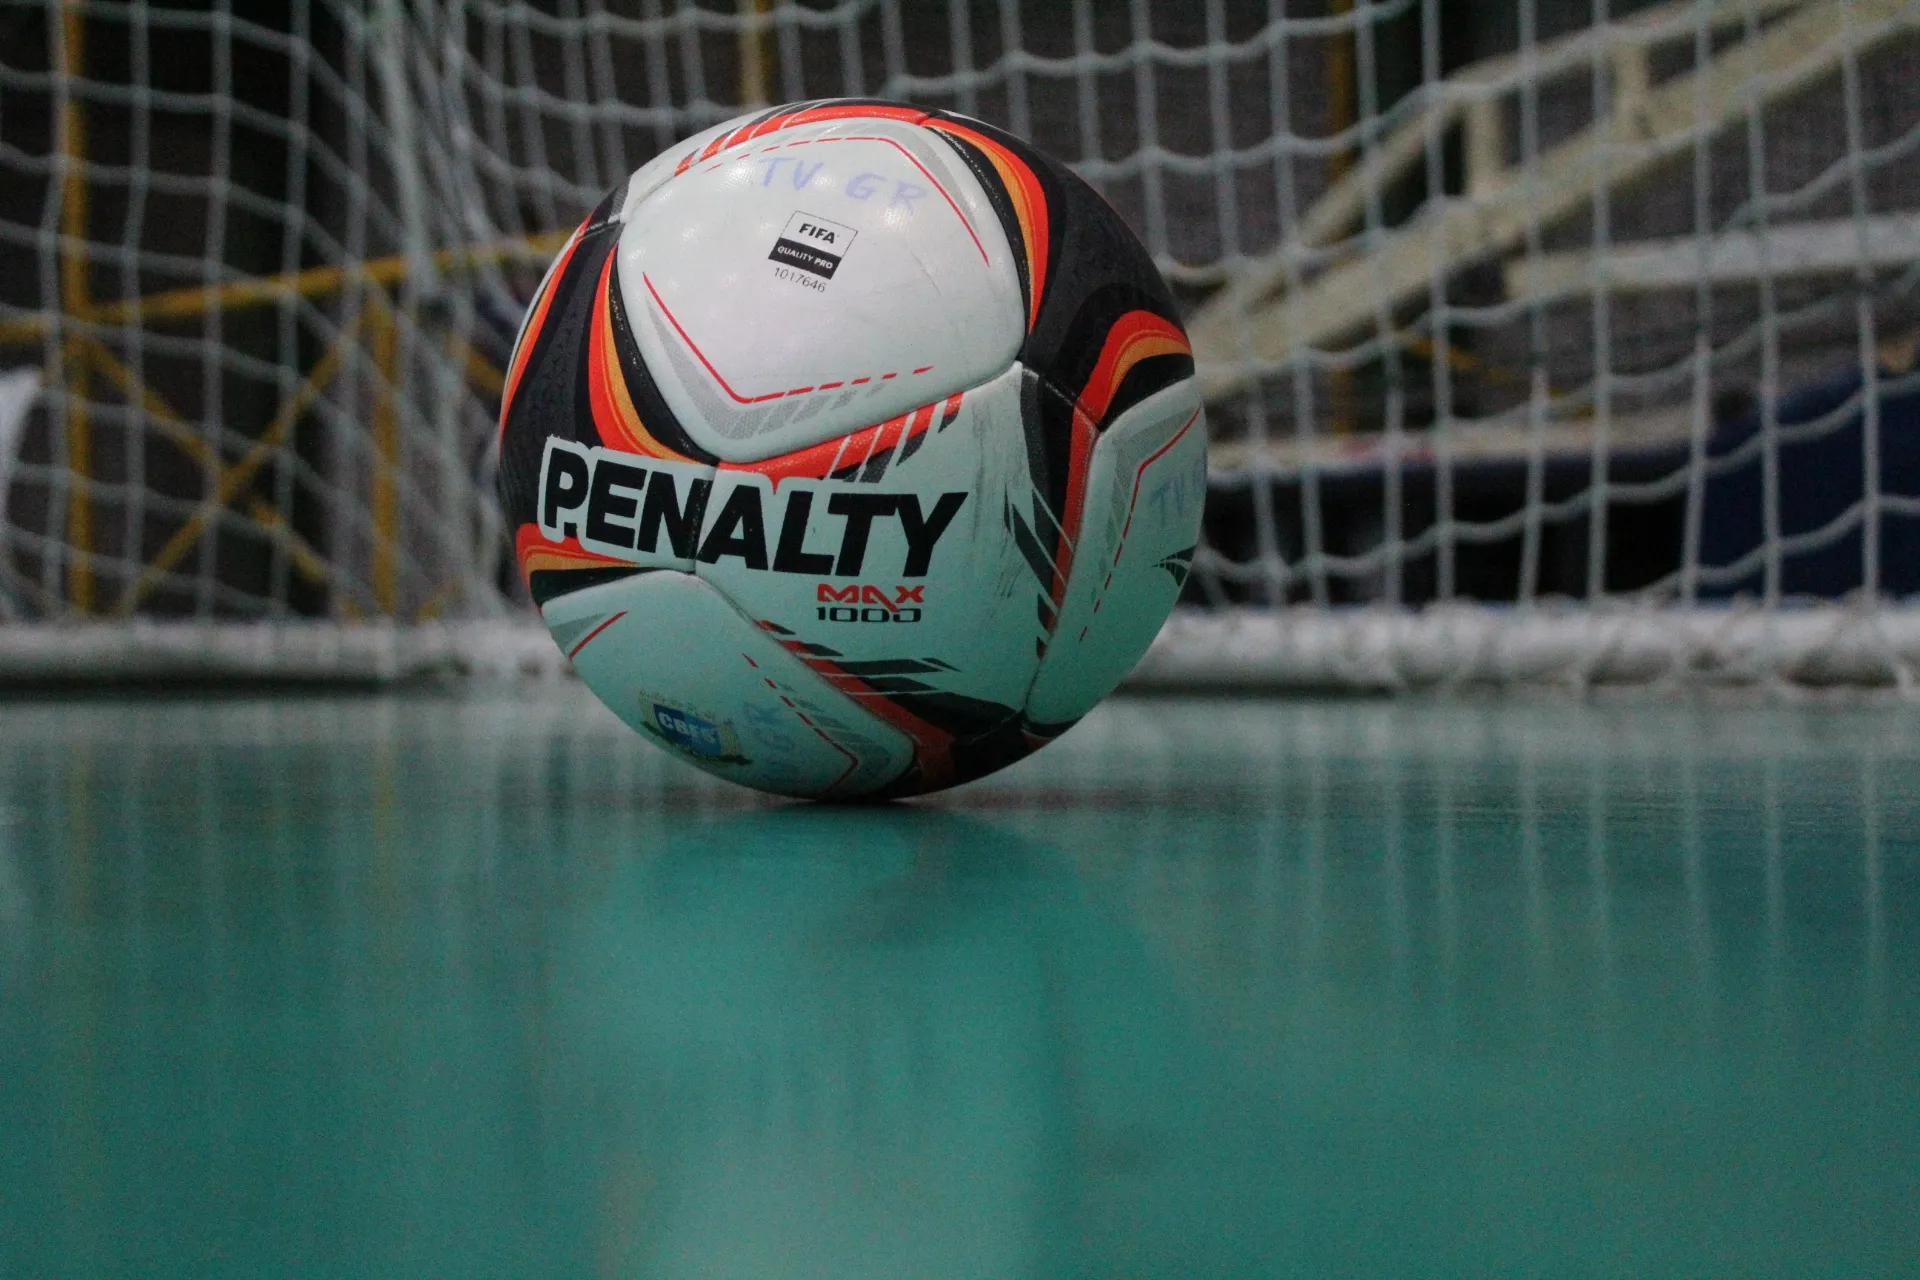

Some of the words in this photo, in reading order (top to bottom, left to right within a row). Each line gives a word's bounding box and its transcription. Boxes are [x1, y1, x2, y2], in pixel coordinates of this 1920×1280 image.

[760, 156, 824, 192] TV
[844, 172, 929, 217] GR
[798, 222, 835, 244] FIFA
[777, 245, 814, 262] QUALITY
[814, 257, 834, 269] PRO
[774, 267, 827, 293] 1017646
[544, 446, 969, 578] PENALTY
[817, 583, 926, 613] MAX
[816, 606, 922, 623] 1000
